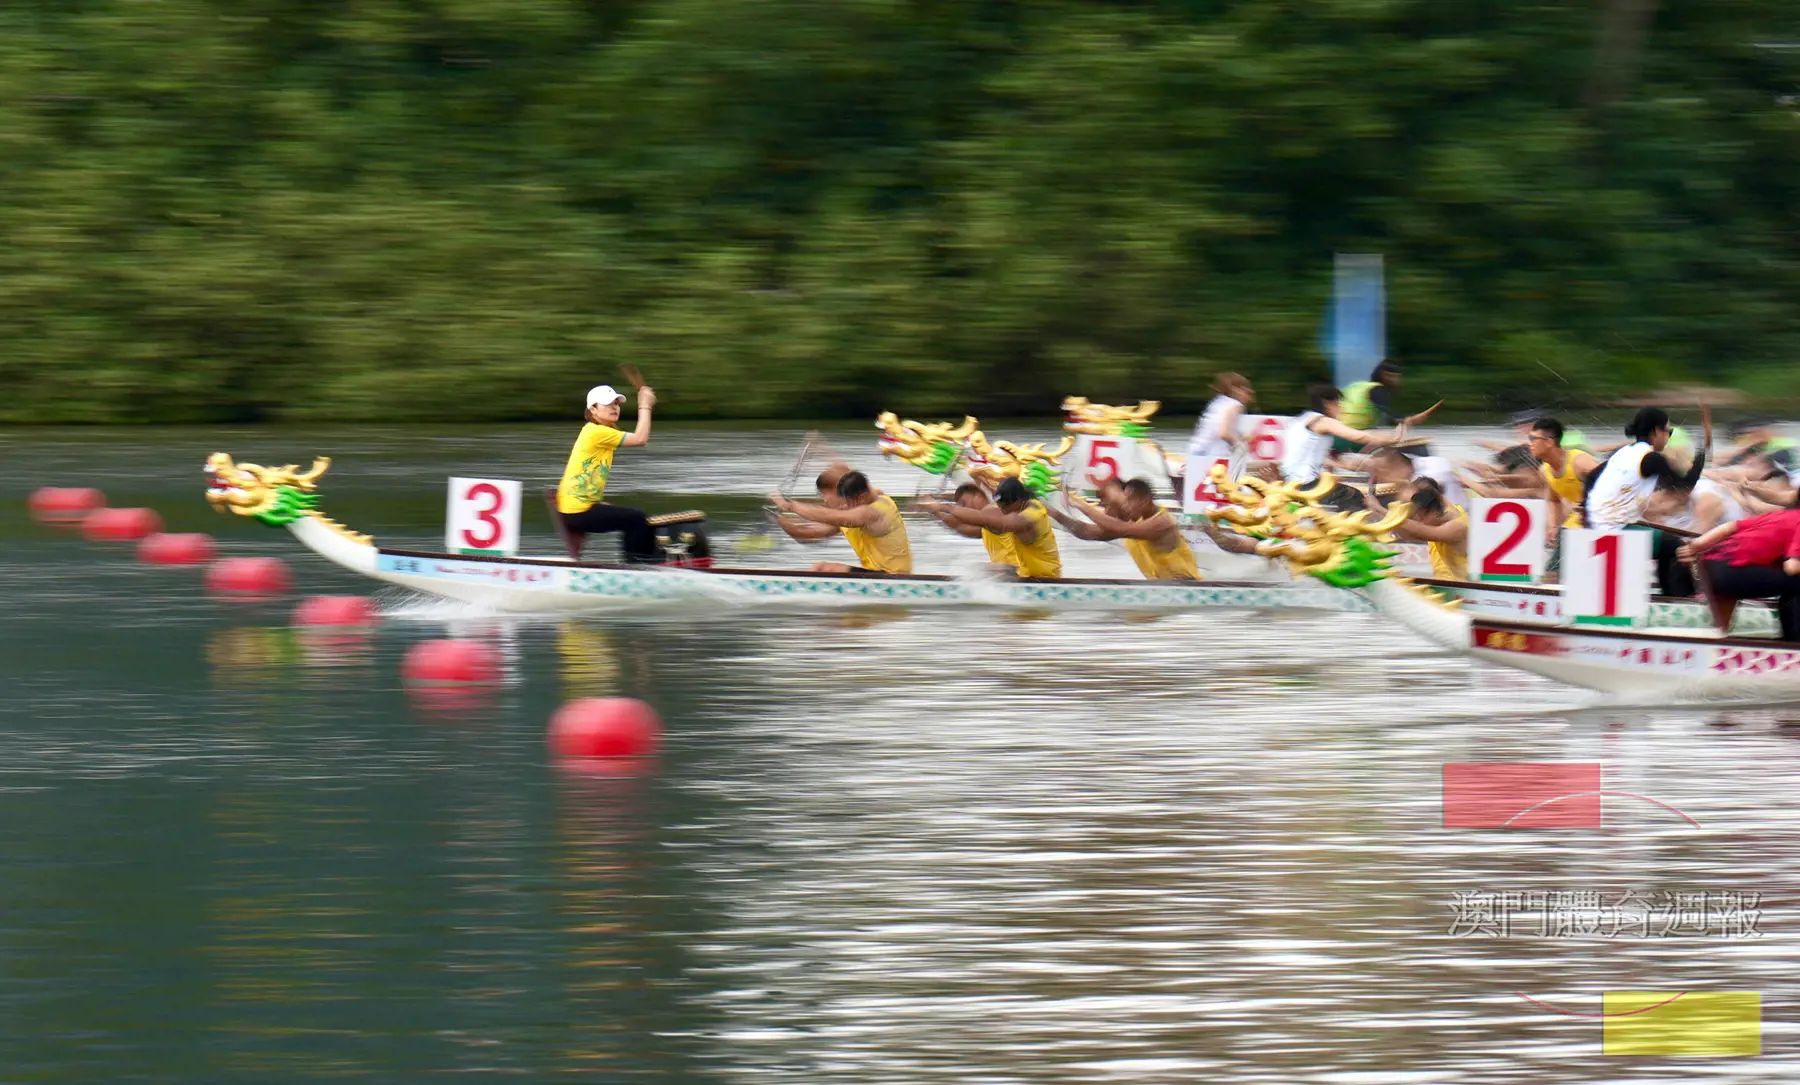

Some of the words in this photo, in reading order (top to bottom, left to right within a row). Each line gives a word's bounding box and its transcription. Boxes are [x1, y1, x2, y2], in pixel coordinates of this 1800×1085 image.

[1086, 440, 1120, 487] 5
[1248, 418, 1285, 460] 6
[462, 483, 503, 548] 3
[1482, 501, 1532, 574] 2
[1593, 534, 1623, 616] 1
